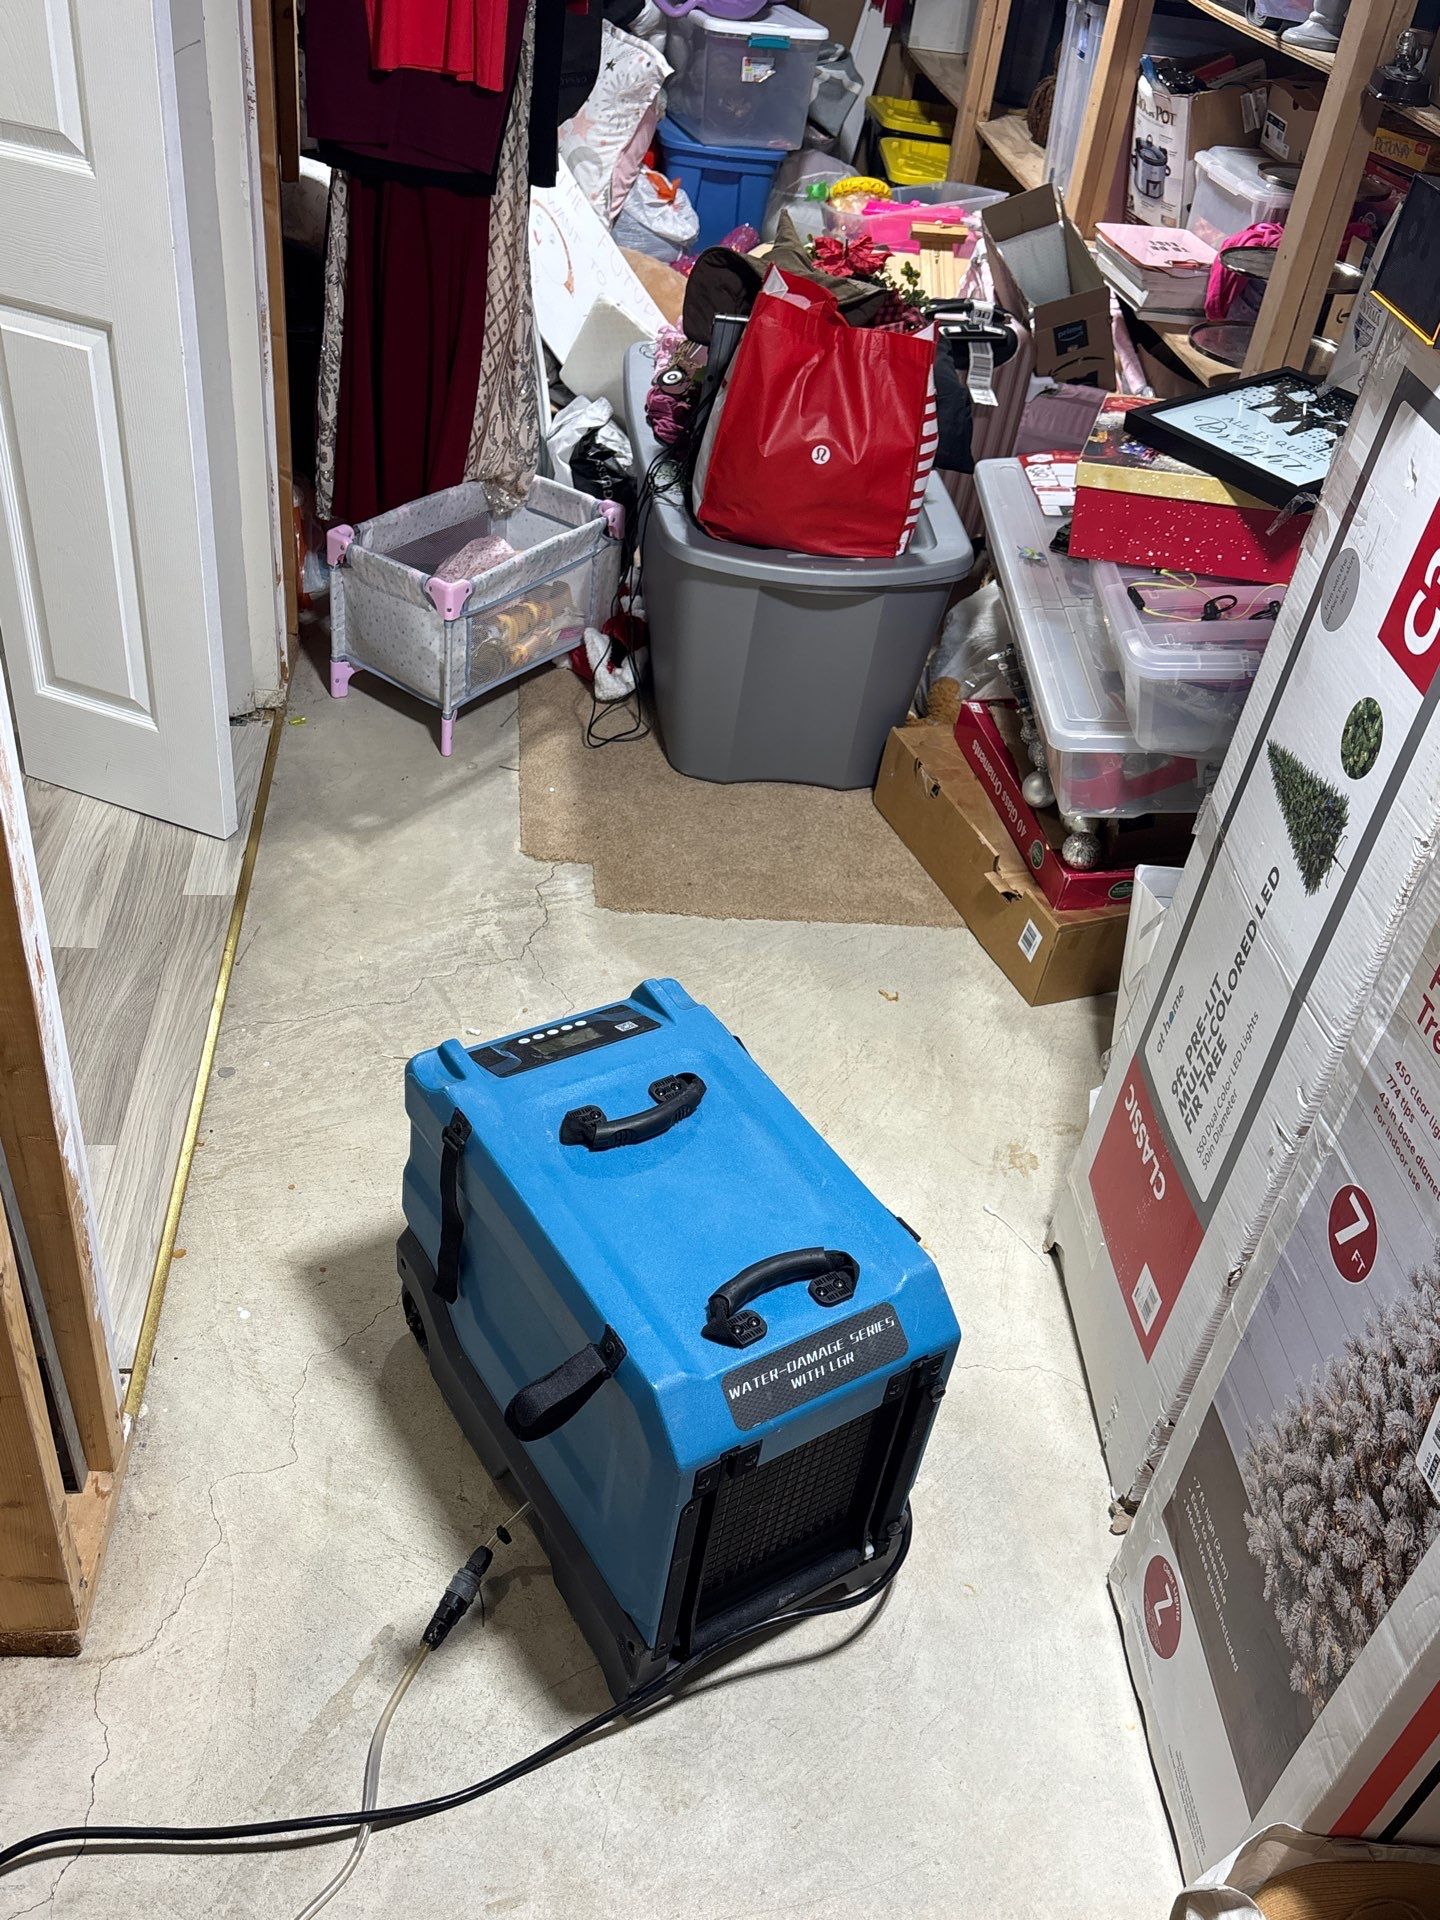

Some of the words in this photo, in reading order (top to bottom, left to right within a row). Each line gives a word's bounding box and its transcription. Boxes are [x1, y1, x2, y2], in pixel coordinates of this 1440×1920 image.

[1193, 415, 1312, 473] Bright
[1222, 417, 1250, 431] ALL
[1253, 430, 1274, 441] IS
[1275, 440, 1327, 463] QUIET
[971, 738, 1002, 796] Ornaments
[1001, 790, 1018, 822] Glass
[1017, 819, 1027, 838] 40
[1177, 919, 1258, 1118] MULTI-COLORED
[1254, 866, 1281, 920] LED
[1156, 1033, 1166, 1054] at
[1171, 1063, 1188, 1098] 9ft
[1184, 971, 1222, 1066] PRE-LIT
[1183, 1094, 1204, 1135] FIR
[1199, 1033, 1228, 1095] TREE
[1204, 1109, 1219, 1140] Dual
[1216, 1075, 1232, 1109] Color
[1230, 1049, 1243, 1077] LED
[1240, 1011, 1260, 1052] Lights
[1386, 1073, 1402, 1100] 774
[1400, 1097, 1416, 1124] tips
[1394, 1060, 1411, 1086] 450
[1410, 1086, 1431, 1118] clear
[1124, 1083, 1166, 1201] CLASSIC
[1202, 1144, 1216, 1171] 50in
[1212, 1088, 1239, 1145] Diameter
[1373, 1104, 1387, 1128] For
[1384, 1125, 1409, 1168] indoor
[1407, 1167, 1421, 1193] use
[1379, 1091, 1390, 1109] 43
[1388, 1106, 1397, 1126] in.
[1397, 1122, 1416, 1155] base
[1334, 1191, 1370, 1246] 7
[1351, 1248, 1366, 1274] FT
[728, 1337, 846, 1400] WATER-DAMAGE
[849, 1315, 896, 1345] SERIES
[790, 1364, 825, 1390] WITH
[829, 1351, 855, 1372] LGR
[1190, 1493, 1203, 1523] Easy
[1201, 1524, 1208, 1540] to
[1206, 1542, 1227, 1605] assemble
[1204, 1507, 1217, 1537] high
[1213, 1537, 1230, 1580] (2.1m)
[1185, 1504, 1200, 1544] Metal
[1198, 1544, 1208, 1571] tree
[1206, 1572, 1220, 1612] stand
[1218, 1611, 1240, 1673] included
